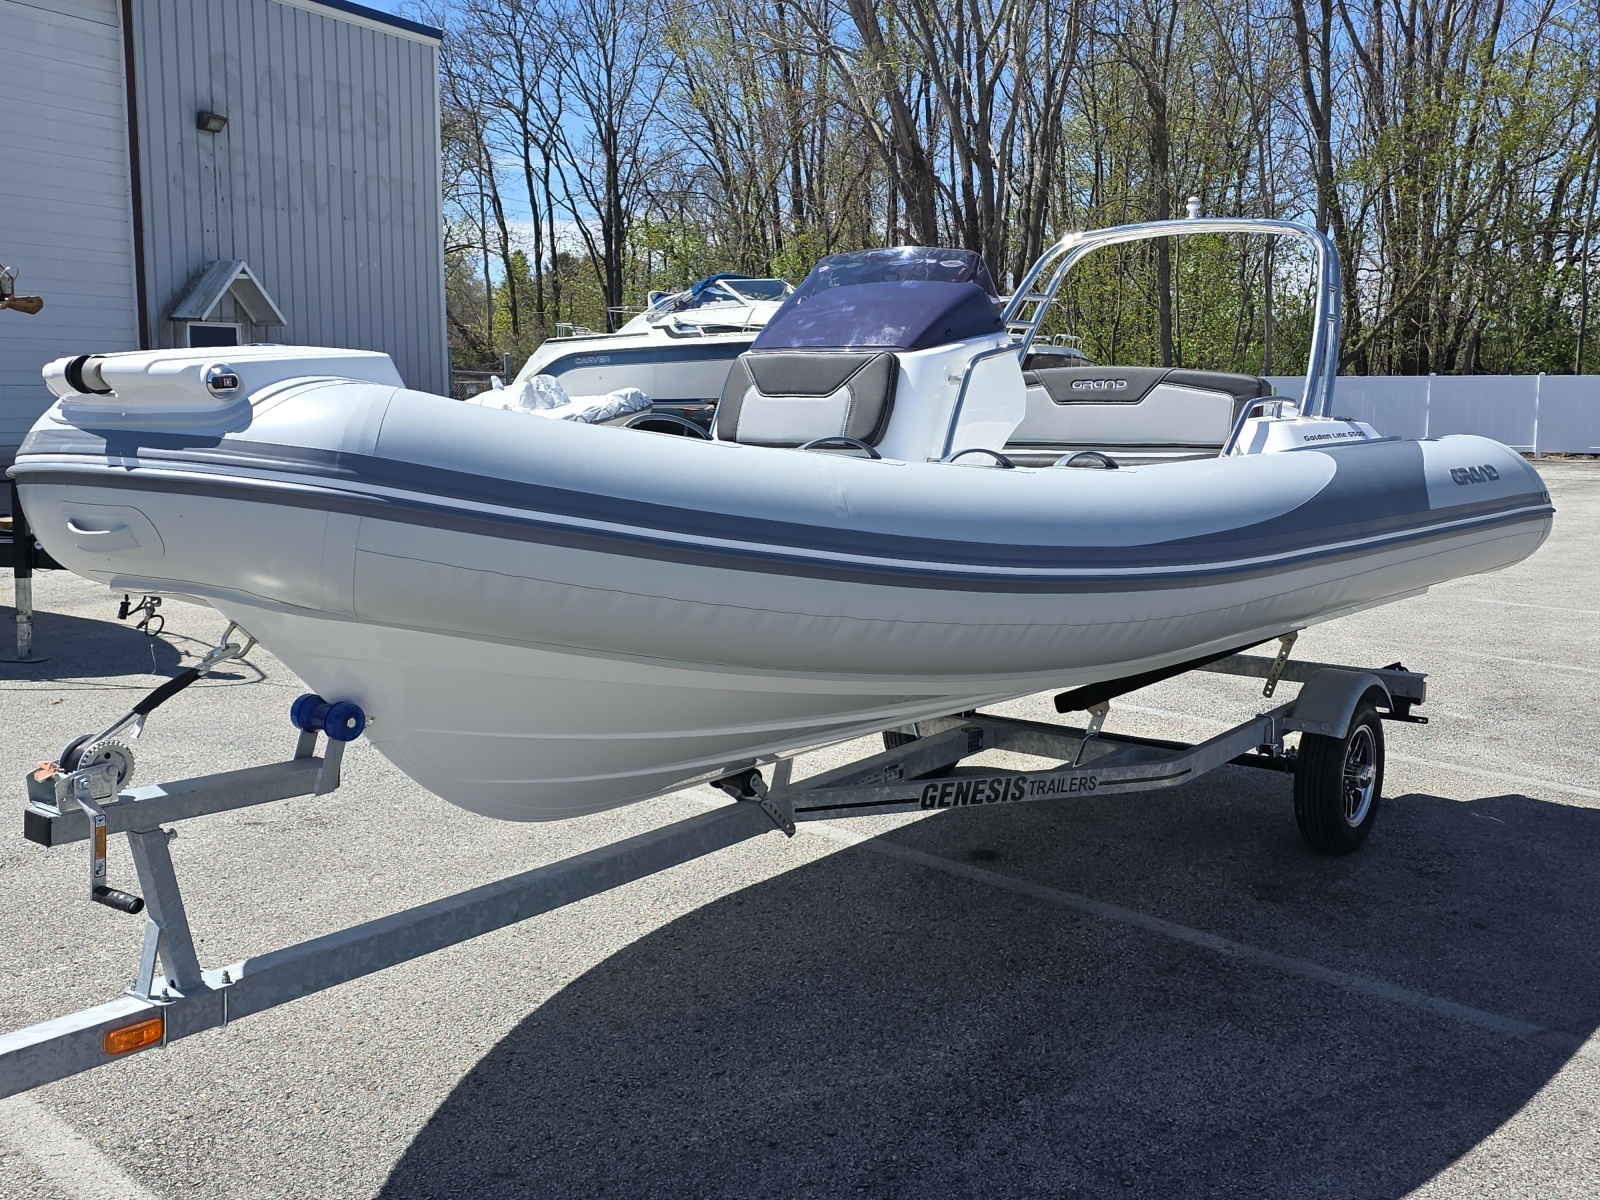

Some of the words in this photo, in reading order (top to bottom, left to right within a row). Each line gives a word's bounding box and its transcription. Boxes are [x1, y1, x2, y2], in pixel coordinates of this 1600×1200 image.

[208, 50, 392, 144] SALES
[173, 137, 418, 229] SERVICE
[575, 355, 611, 365] CARVER
[1071, 379, 1128, 391] GRAND
[1303, 433, 1332, 442] Golden
[1449, 464, 1500, 486] GRAND
[920, 776, 1028, 810] GENESIS
[1029, 775, 1097, 796] TRAILERS
